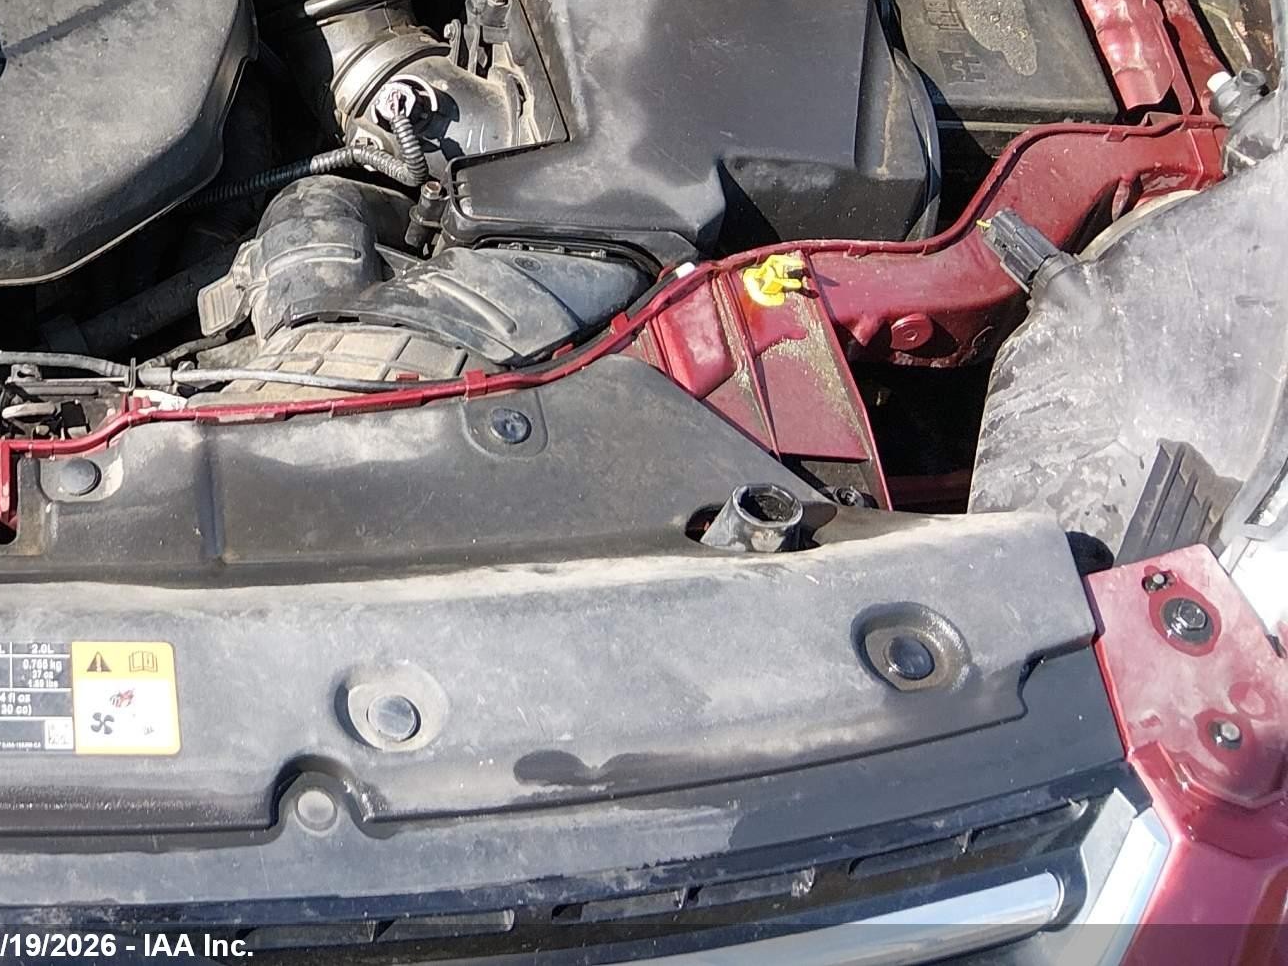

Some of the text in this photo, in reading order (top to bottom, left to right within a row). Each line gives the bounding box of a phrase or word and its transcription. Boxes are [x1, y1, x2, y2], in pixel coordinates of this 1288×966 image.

[31, 644, 54, 654] 2.0L
[50, 658, 62, 673] kg
[8, 692, 16, 703] fl
[17, 694, 31, 703] oz
